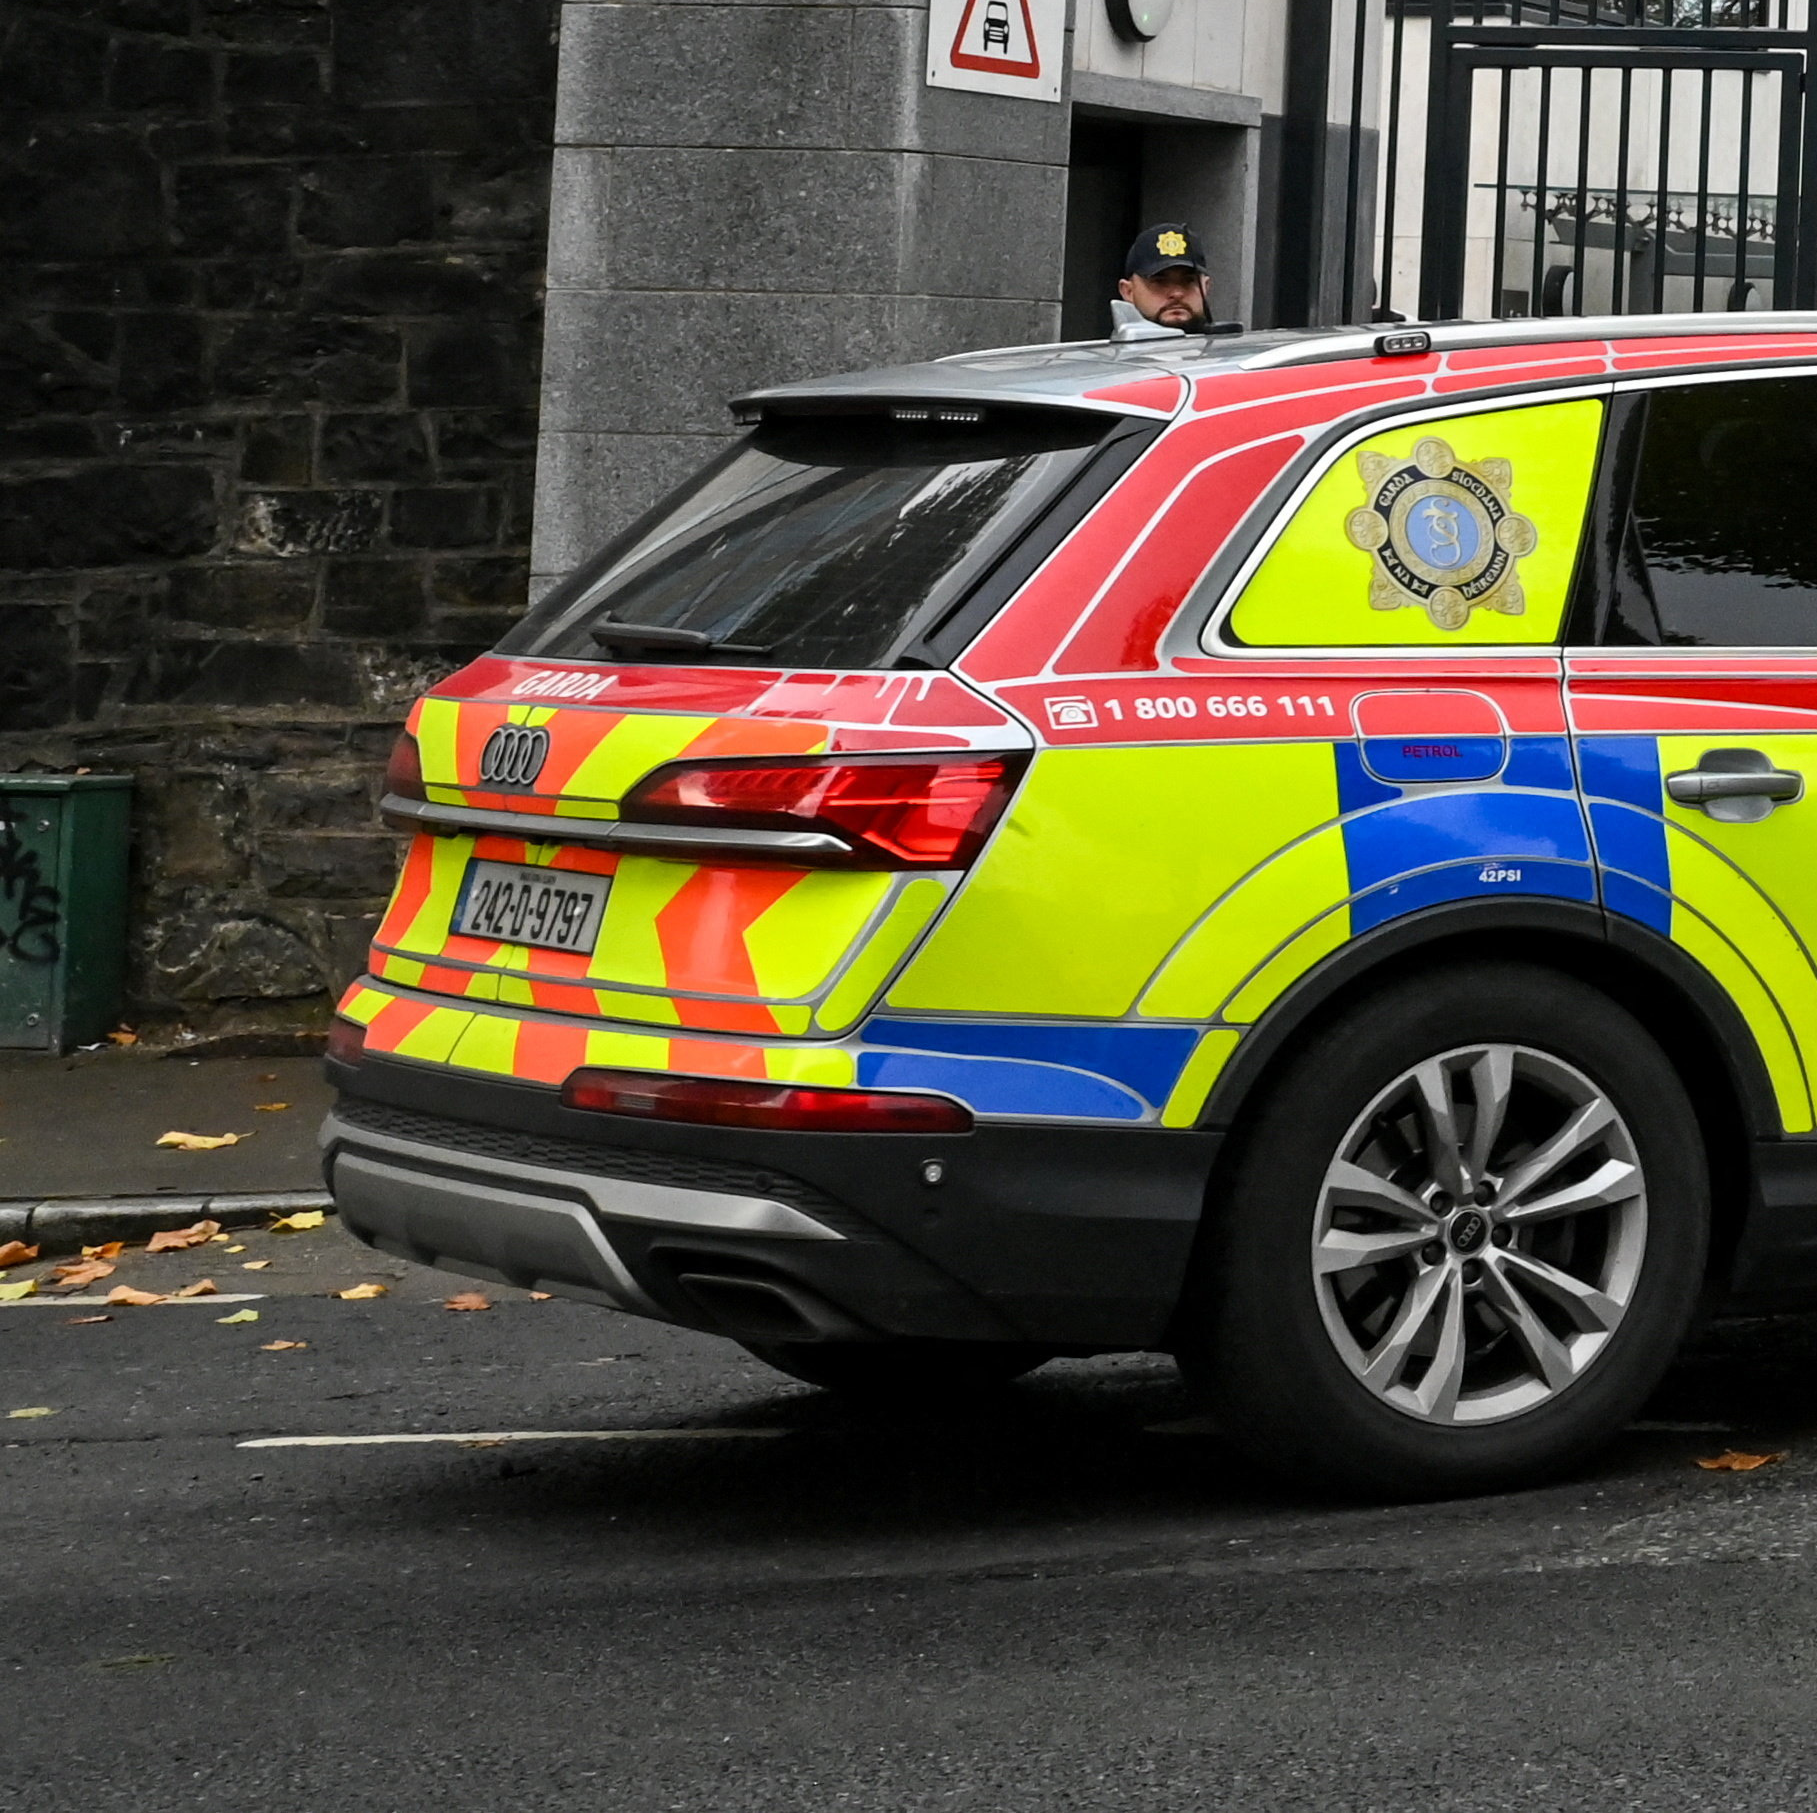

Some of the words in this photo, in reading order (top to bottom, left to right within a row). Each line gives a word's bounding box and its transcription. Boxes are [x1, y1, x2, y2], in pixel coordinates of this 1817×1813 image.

[1379, 473, 1415, 506] GARDA
[511, 670, 619, 700] GARDA
[1104, 698, 1124, 720] 1
[1134, 697, 1197, 719] 800
[1206, 696, 1268, 717] 666
[1276, 695, 1336, 717] 111
[1402, 745, 1463, 758] PETROL
[1478, 869, 1522, 883] 42PSI
[470, 880, 594, 946] 242-D-9797
